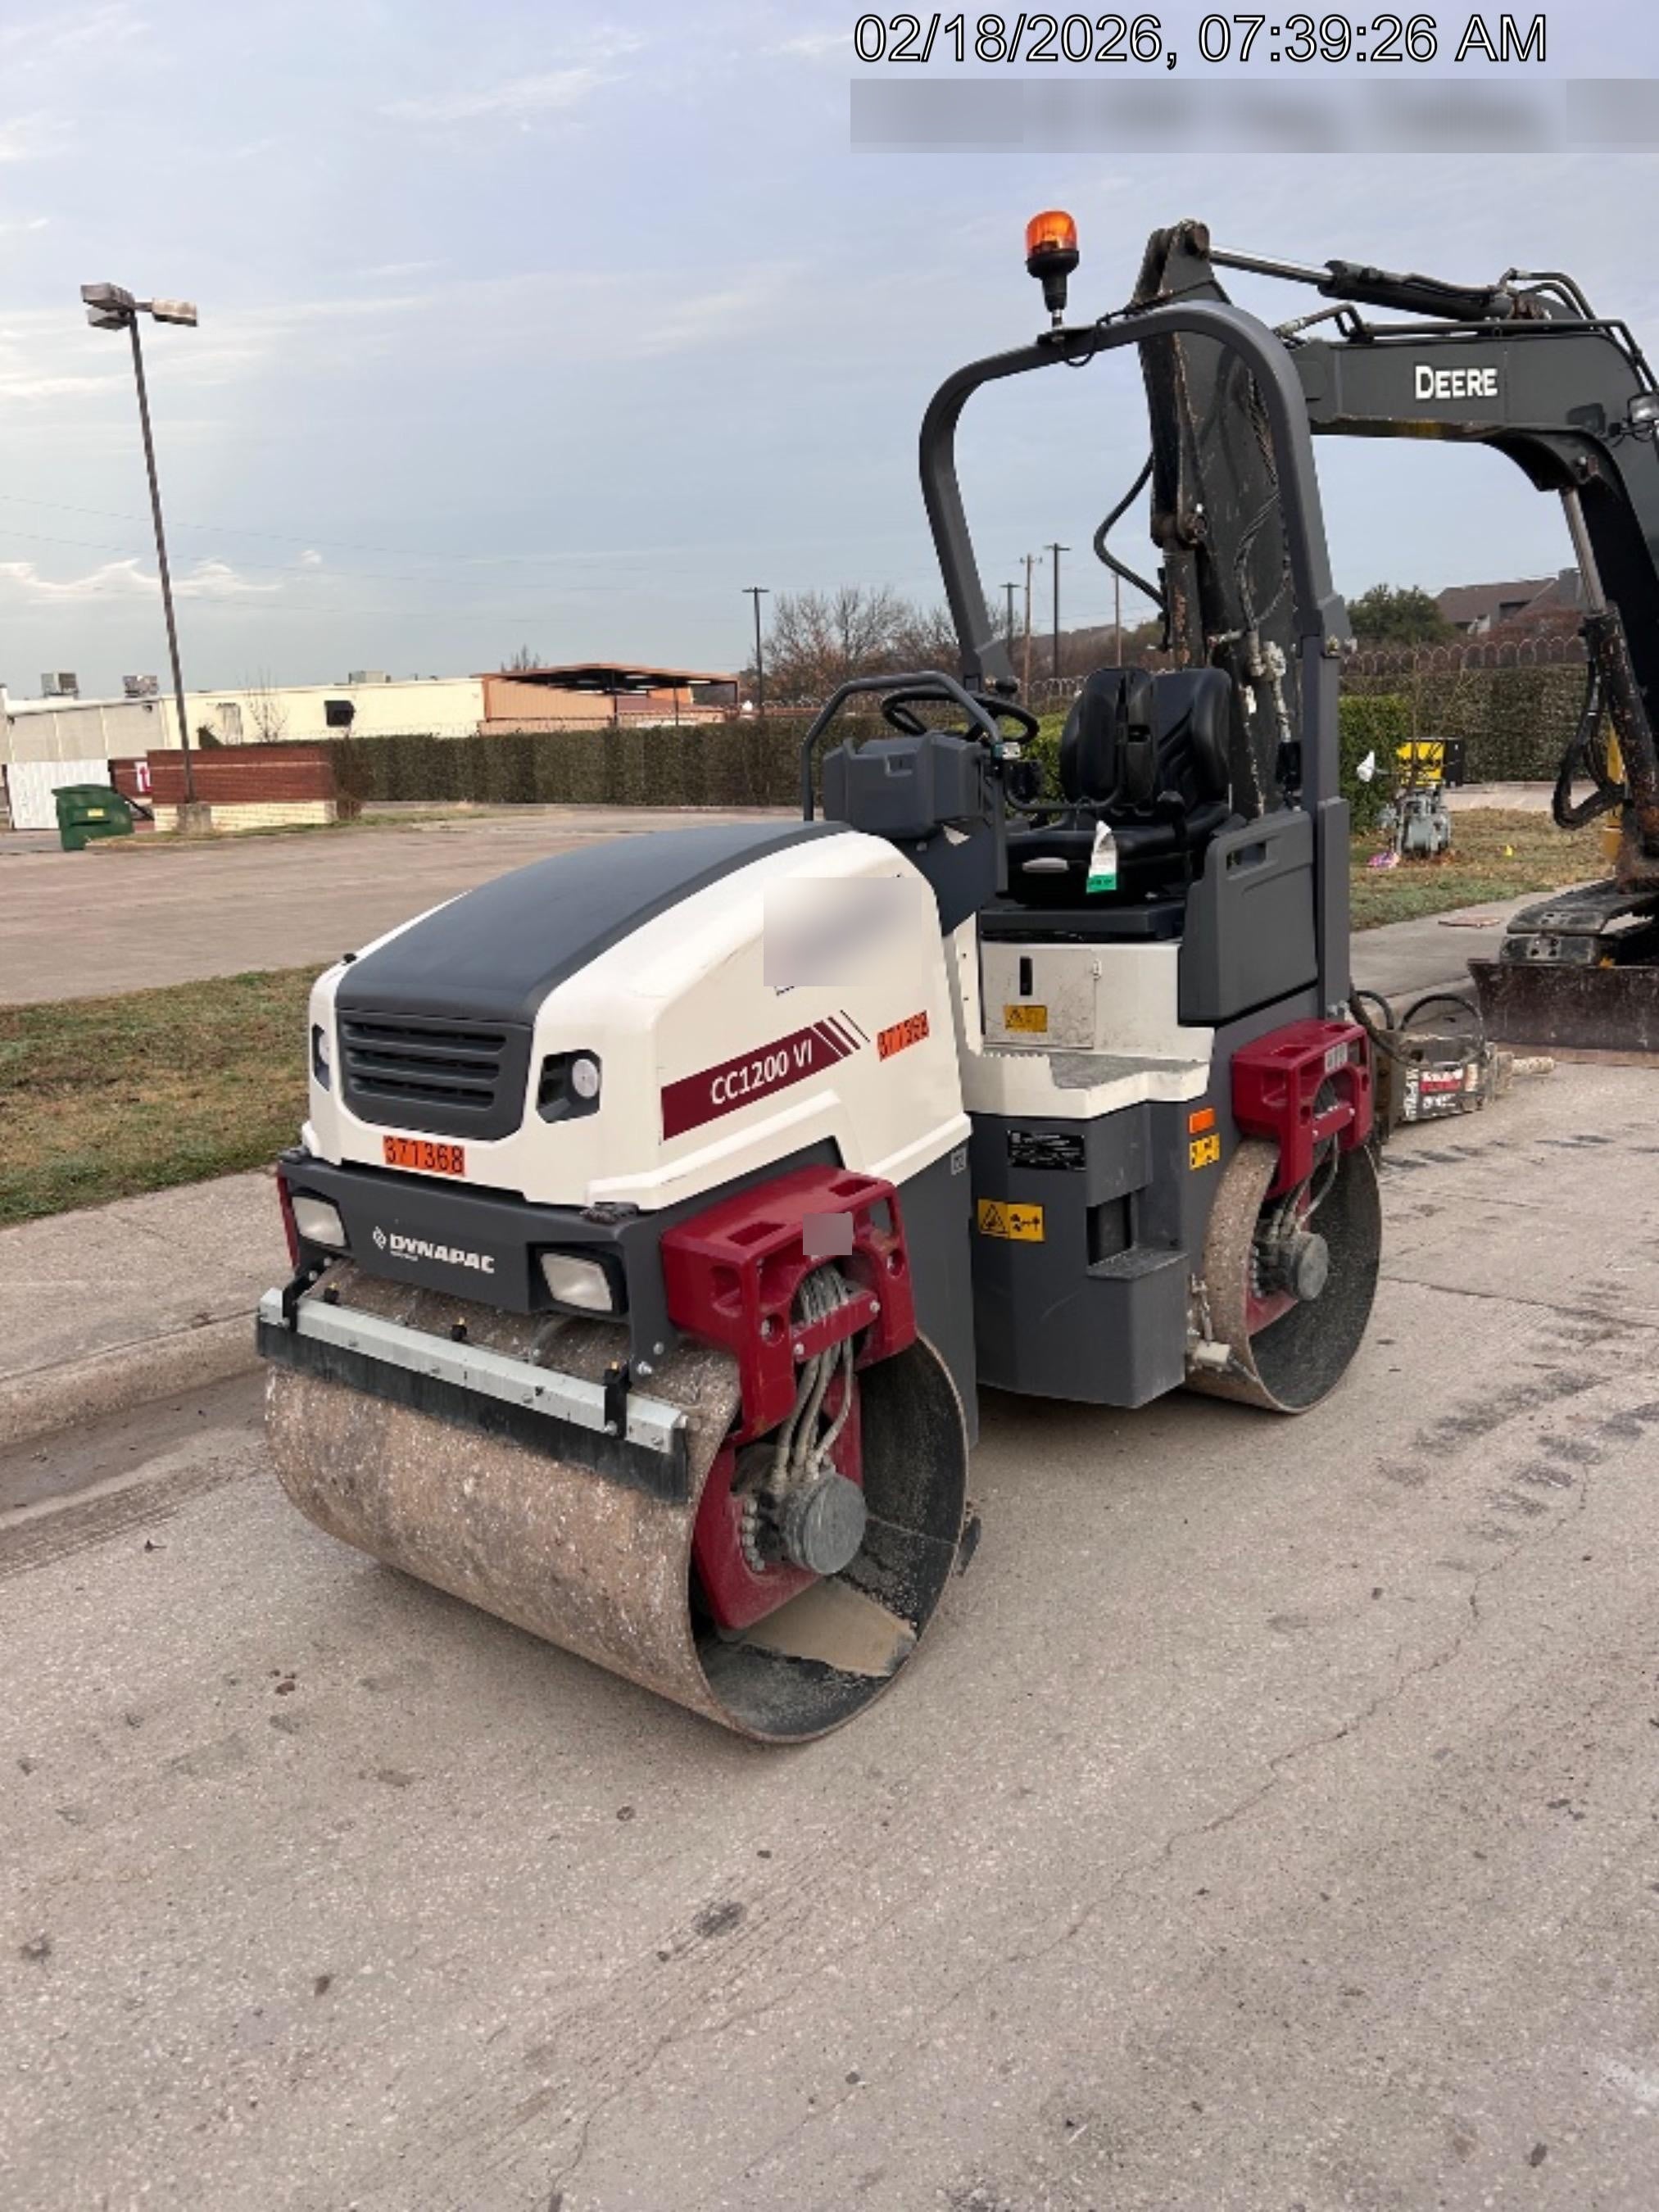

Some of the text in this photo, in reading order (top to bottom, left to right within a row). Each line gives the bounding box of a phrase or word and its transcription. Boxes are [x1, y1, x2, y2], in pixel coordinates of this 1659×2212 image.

[1414, 365, 1498, 400] DEERE
[710, 1038, 813, 1104] CC1200 VI
[384, 1135, 465, 1174] 371368
[390, 1233, 496, 1274] DYNAPAC
